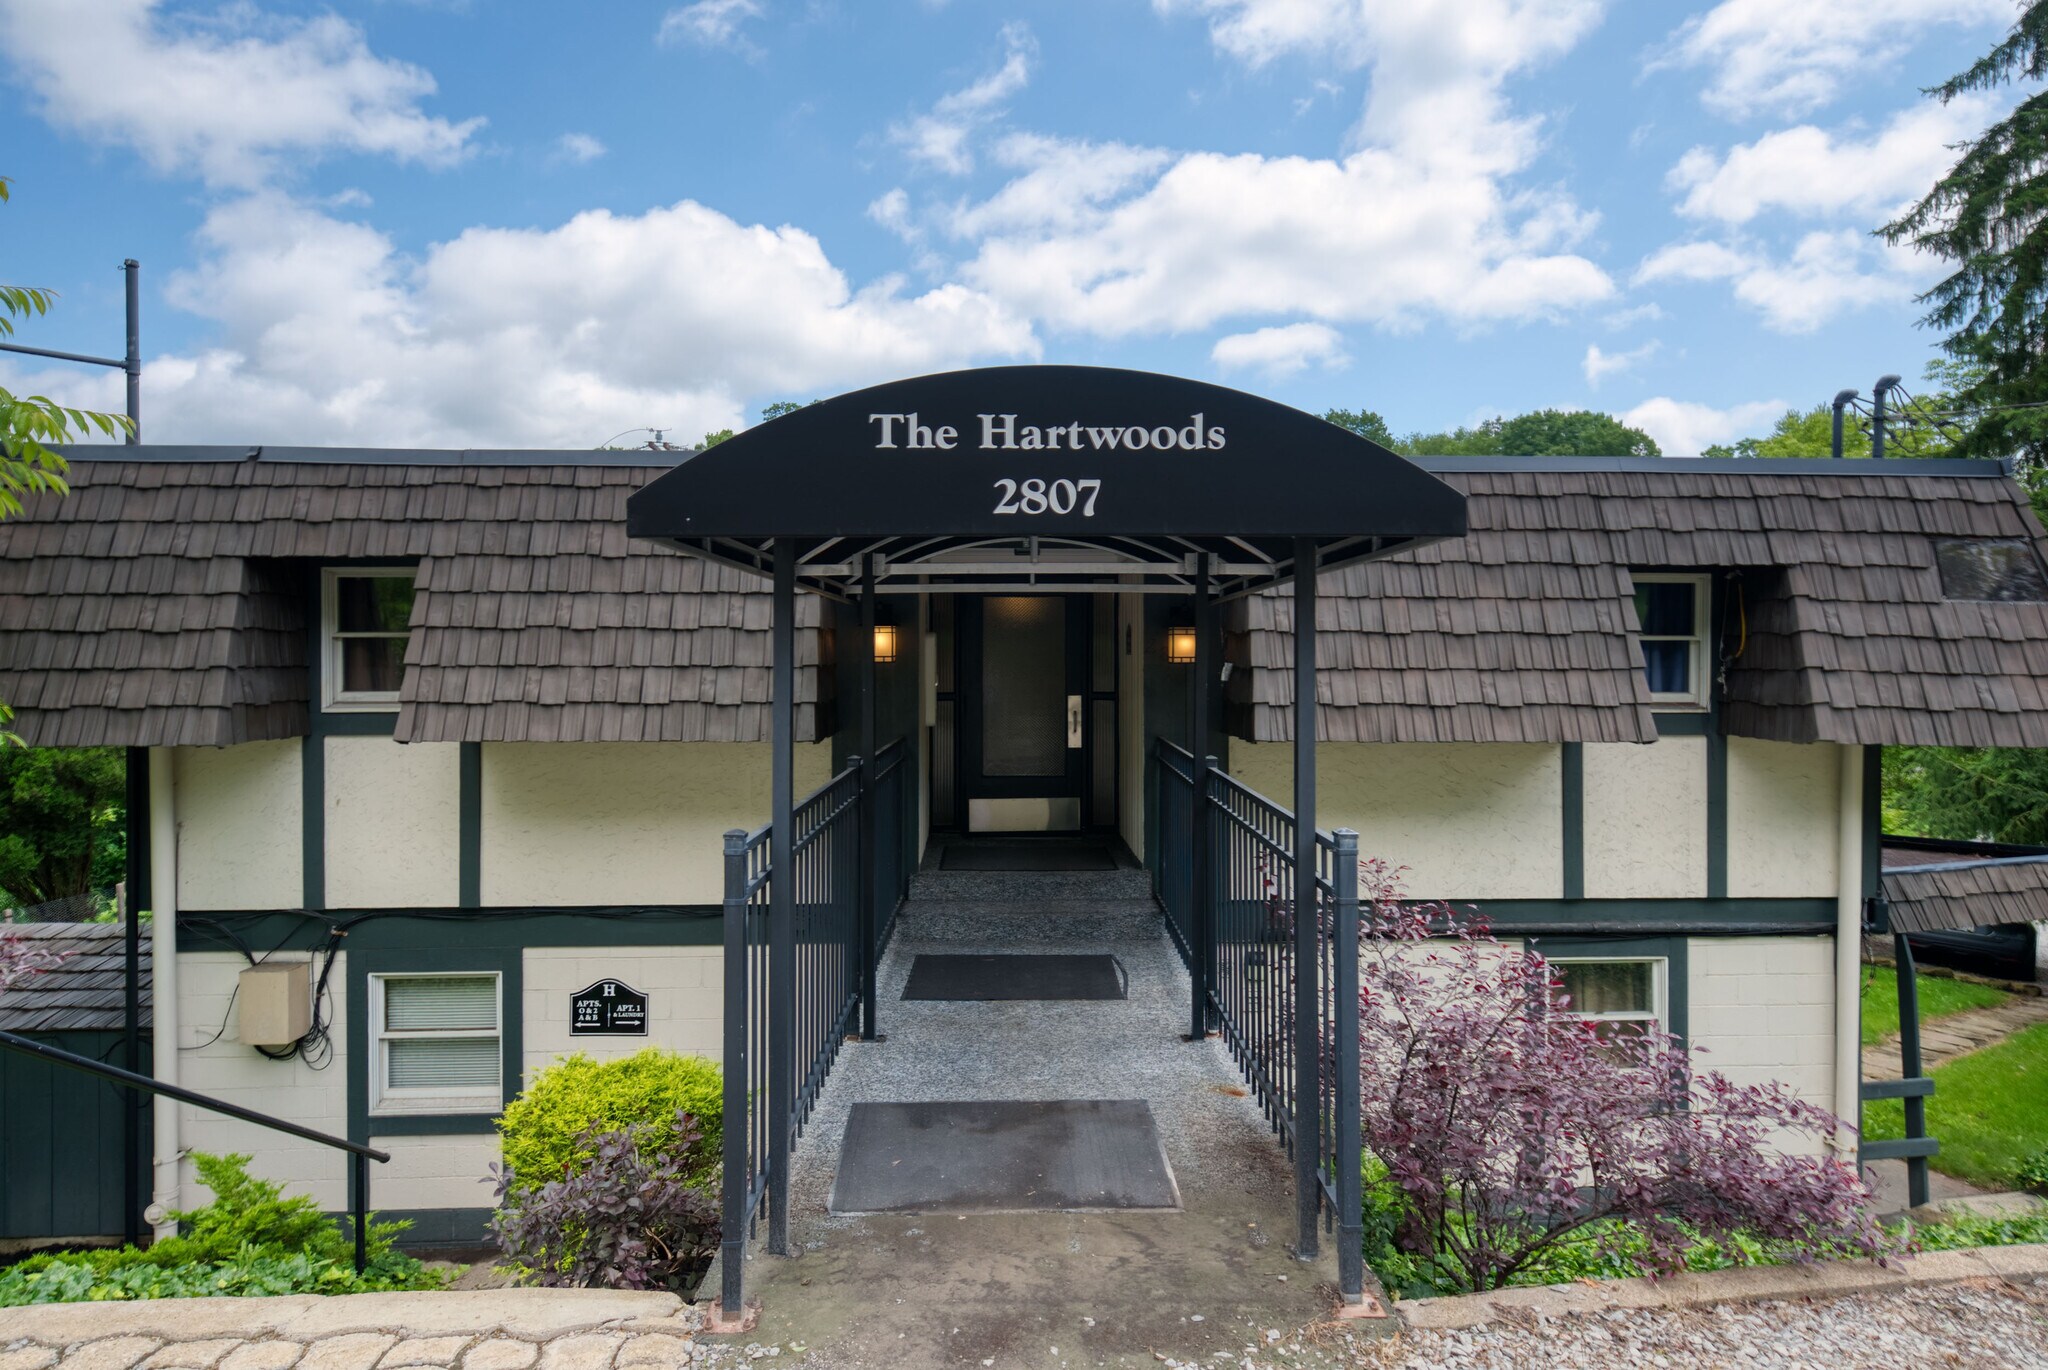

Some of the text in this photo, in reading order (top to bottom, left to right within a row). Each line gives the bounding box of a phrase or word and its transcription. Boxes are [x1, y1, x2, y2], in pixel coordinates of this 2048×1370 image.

[868, 412, 1227, 451] The Hartwoods
[992, 477, 1102, 518] 2807
[603, 984, 616, 996] H
